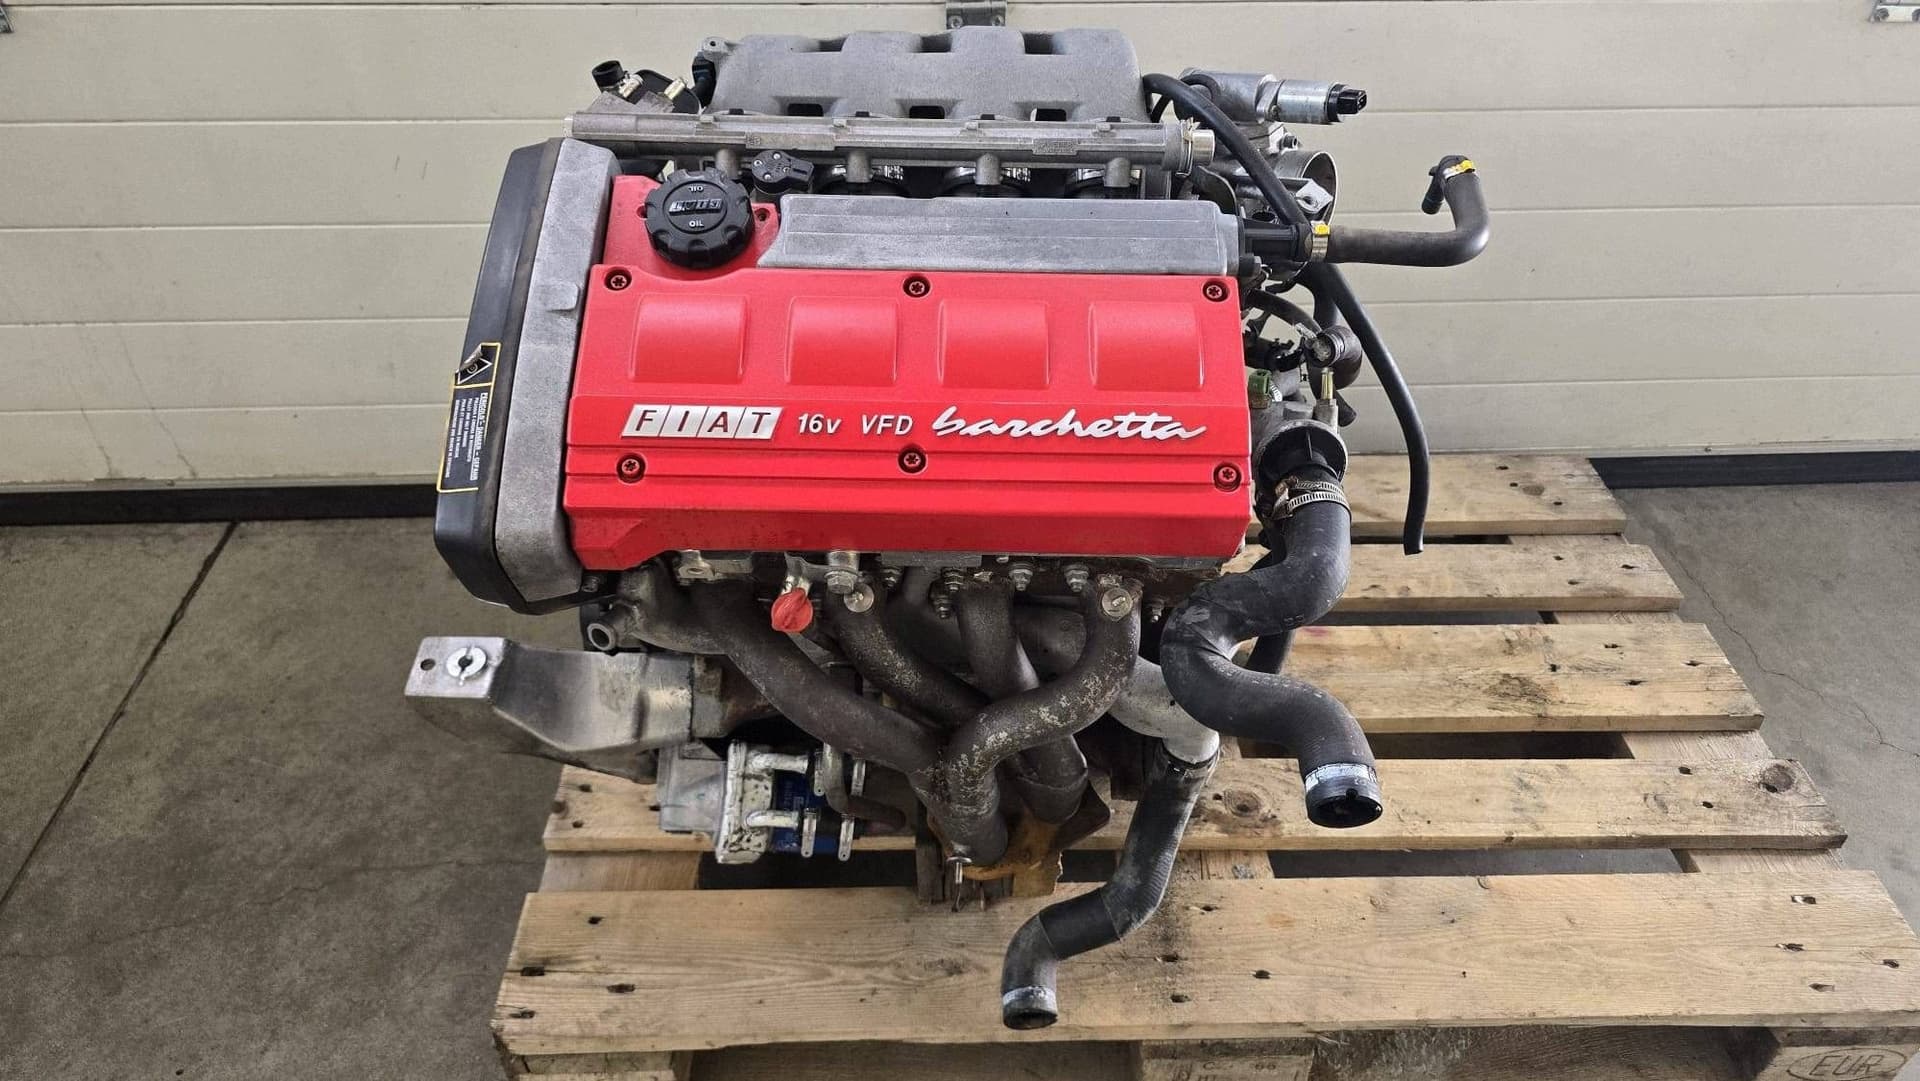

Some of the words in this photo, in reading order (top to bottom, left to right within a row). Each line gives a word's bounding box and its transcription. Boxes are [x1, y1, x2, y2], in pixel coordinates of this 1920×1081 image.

[634, 407, 774, 436] FIAT
[797, 413, 841, 435] 16v
[861, 414, 914, 436] VFD
[932, 405, 1206, 440] barchetta
[1808, 1054, 1886, 1076] EUR
